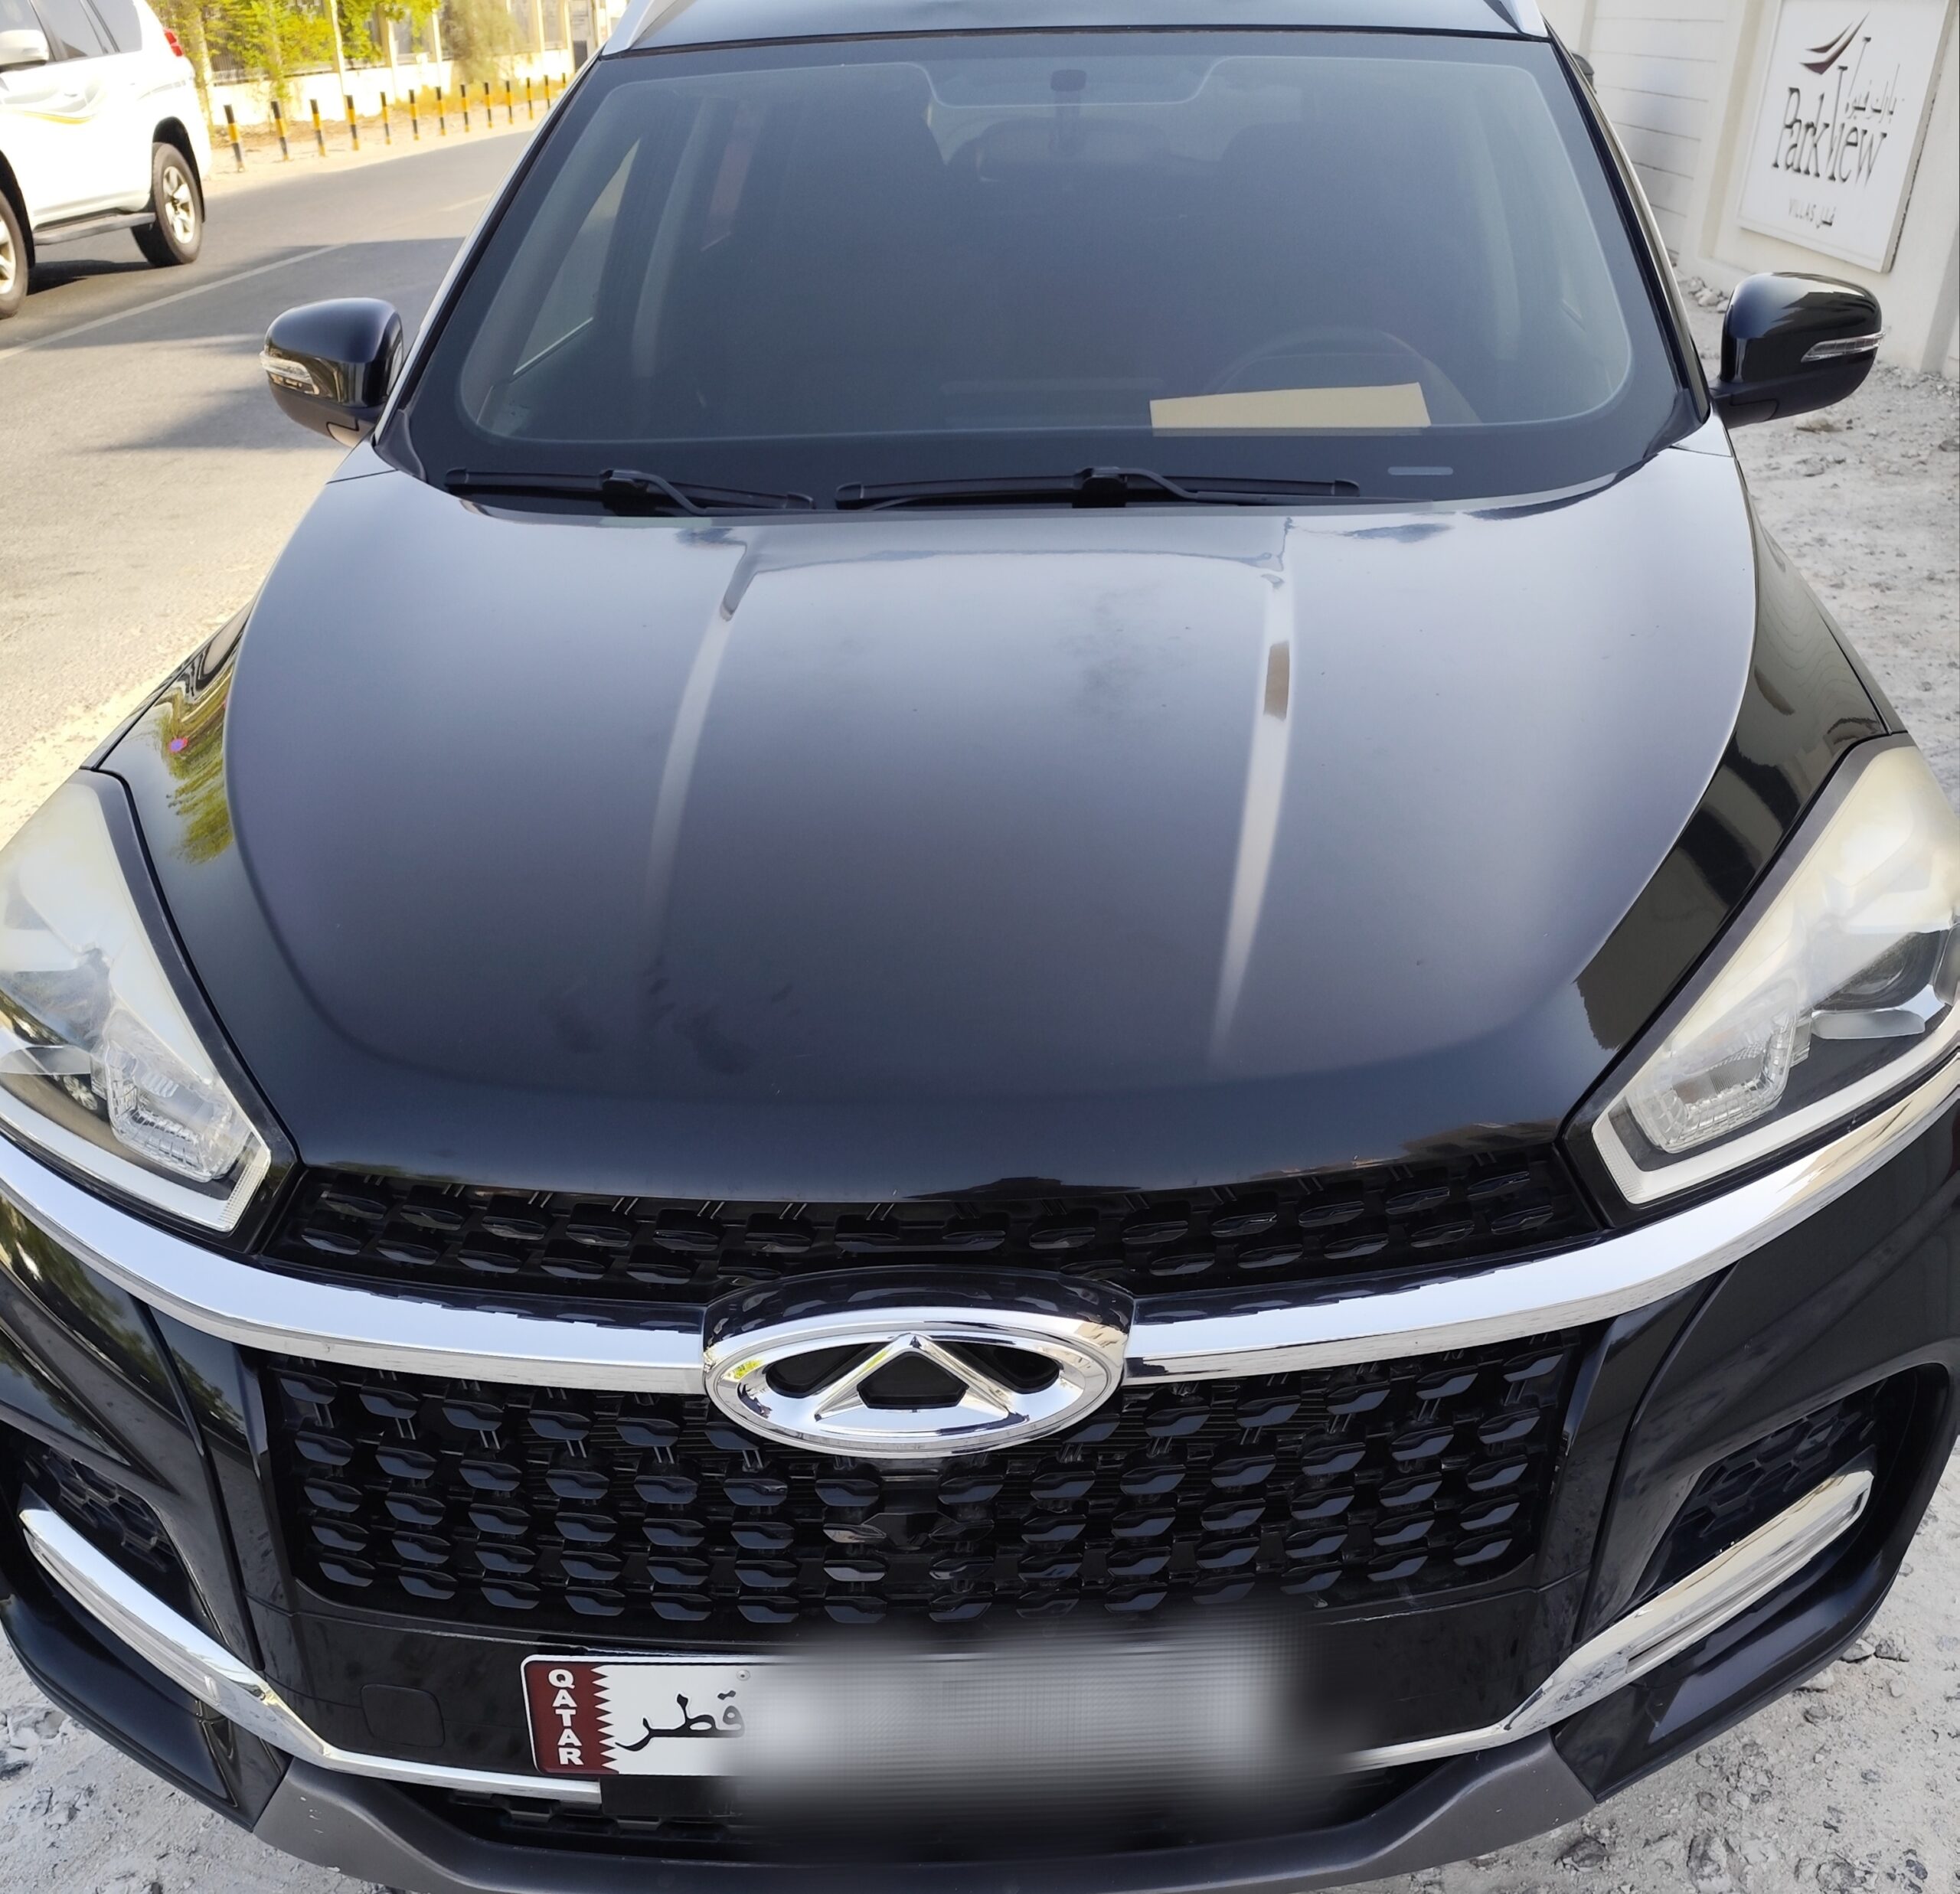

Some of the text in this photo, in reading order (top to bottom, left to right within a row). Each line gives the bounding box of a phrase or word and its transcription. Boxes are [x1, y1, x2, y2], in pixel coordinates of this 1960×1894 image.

[1788, 198, 1817, 223] VILLAS
[547, 1668, 584, 1766] QATAR
[615, 1690, 746, 1752] قطر
